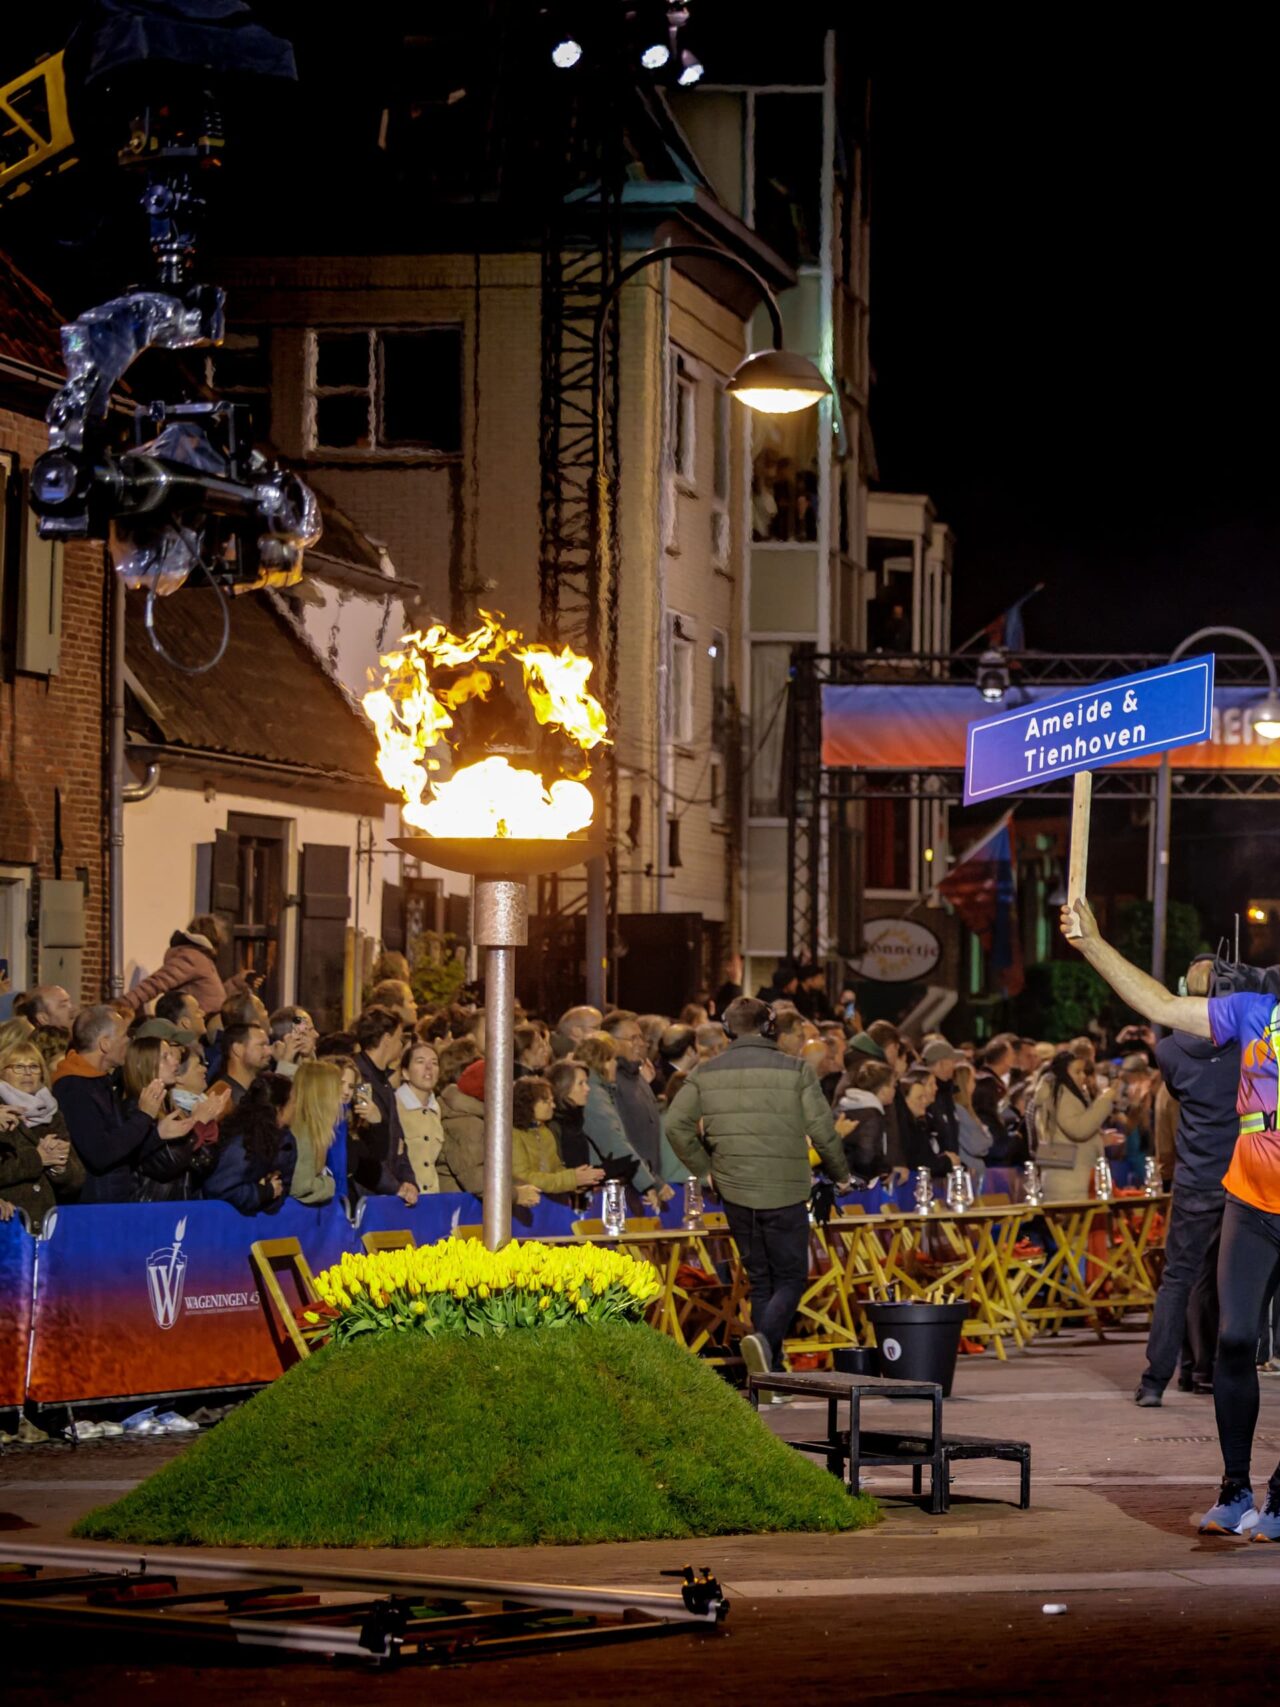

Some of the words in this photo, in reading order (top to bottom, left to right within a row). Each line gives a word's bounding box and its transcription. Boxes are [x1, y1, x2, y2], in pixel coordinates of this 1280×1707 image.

[1025, 699, 1112, 742] Ameide
[1122, 689, 1138, 713] &
[1024, 725, 1146, 773] Tienhoven
[184, 1292, 248, 1309] WAGENINGEN
